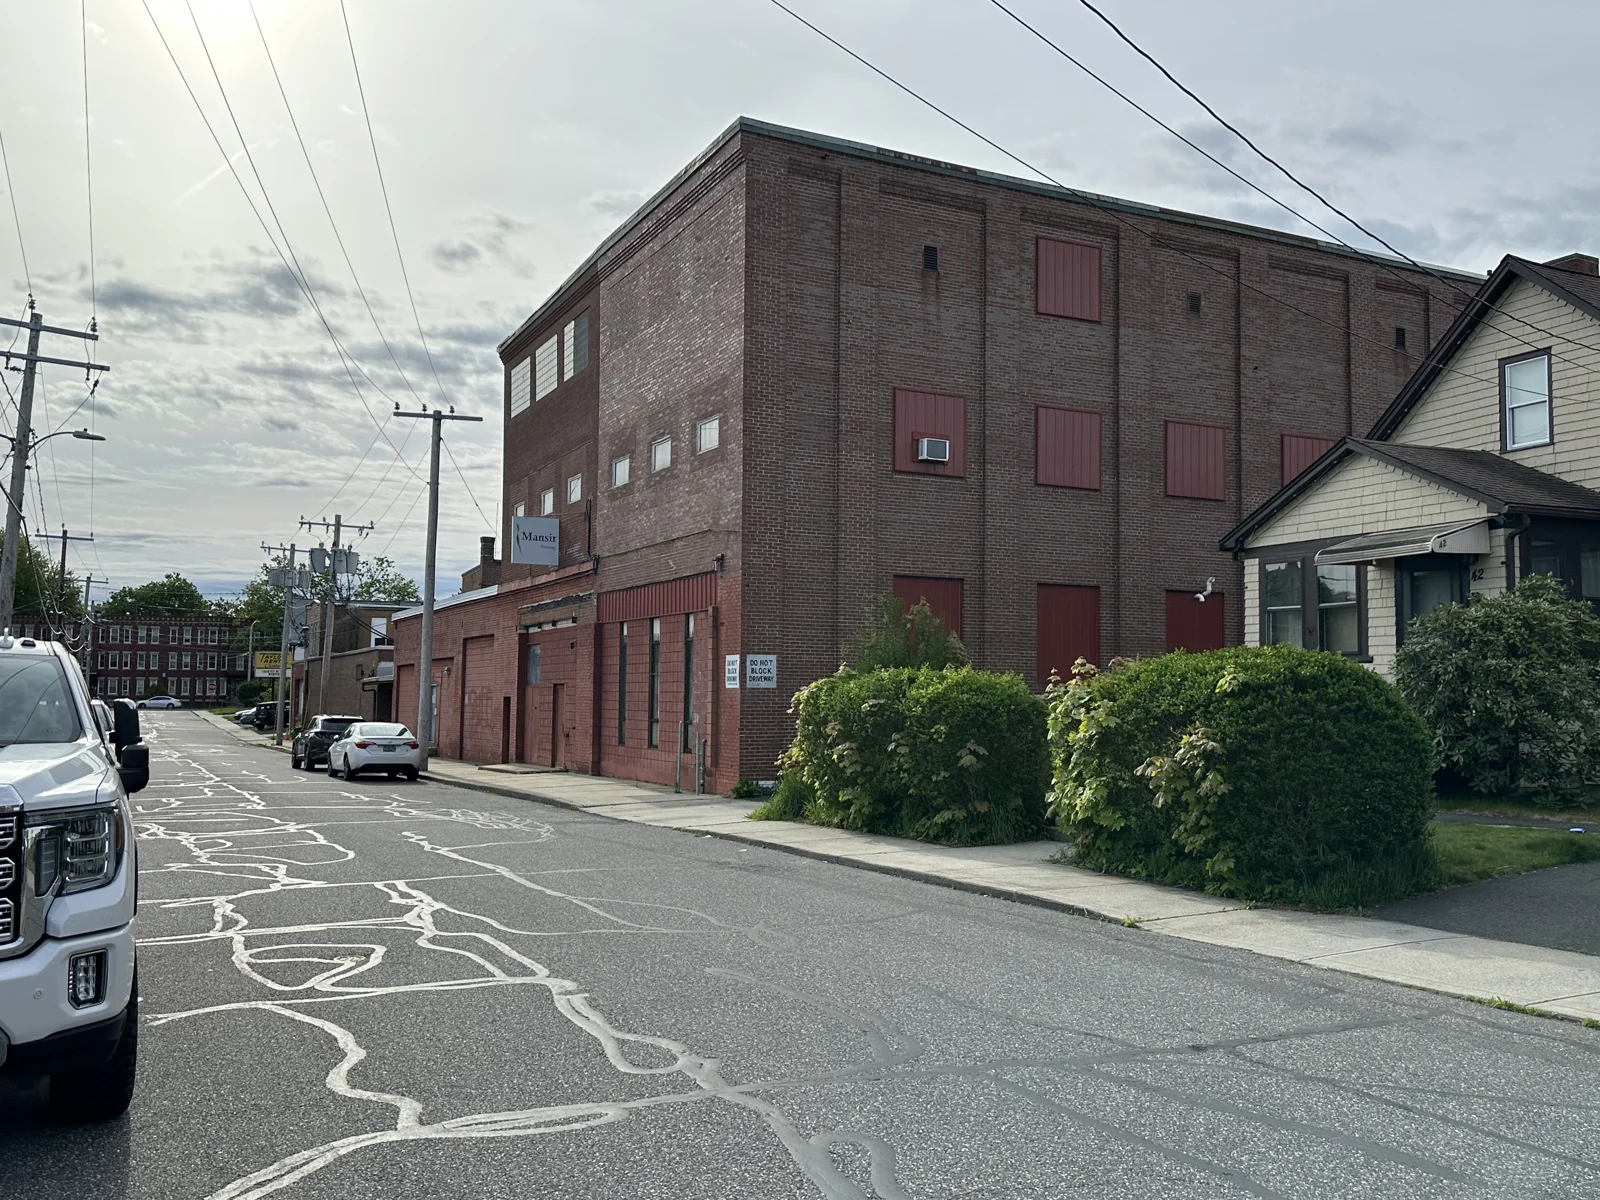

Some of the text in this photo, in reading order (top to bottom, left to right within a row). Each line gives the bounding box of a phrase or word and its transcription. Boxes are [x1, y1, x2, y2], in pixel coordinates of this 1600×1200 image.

[522, 532, 557, 542] Mansir
[1439, 540, 1447, 549] 42
[1471, 568, 1484, 581] 42
[259, 652, 282, 662] TAYLO
